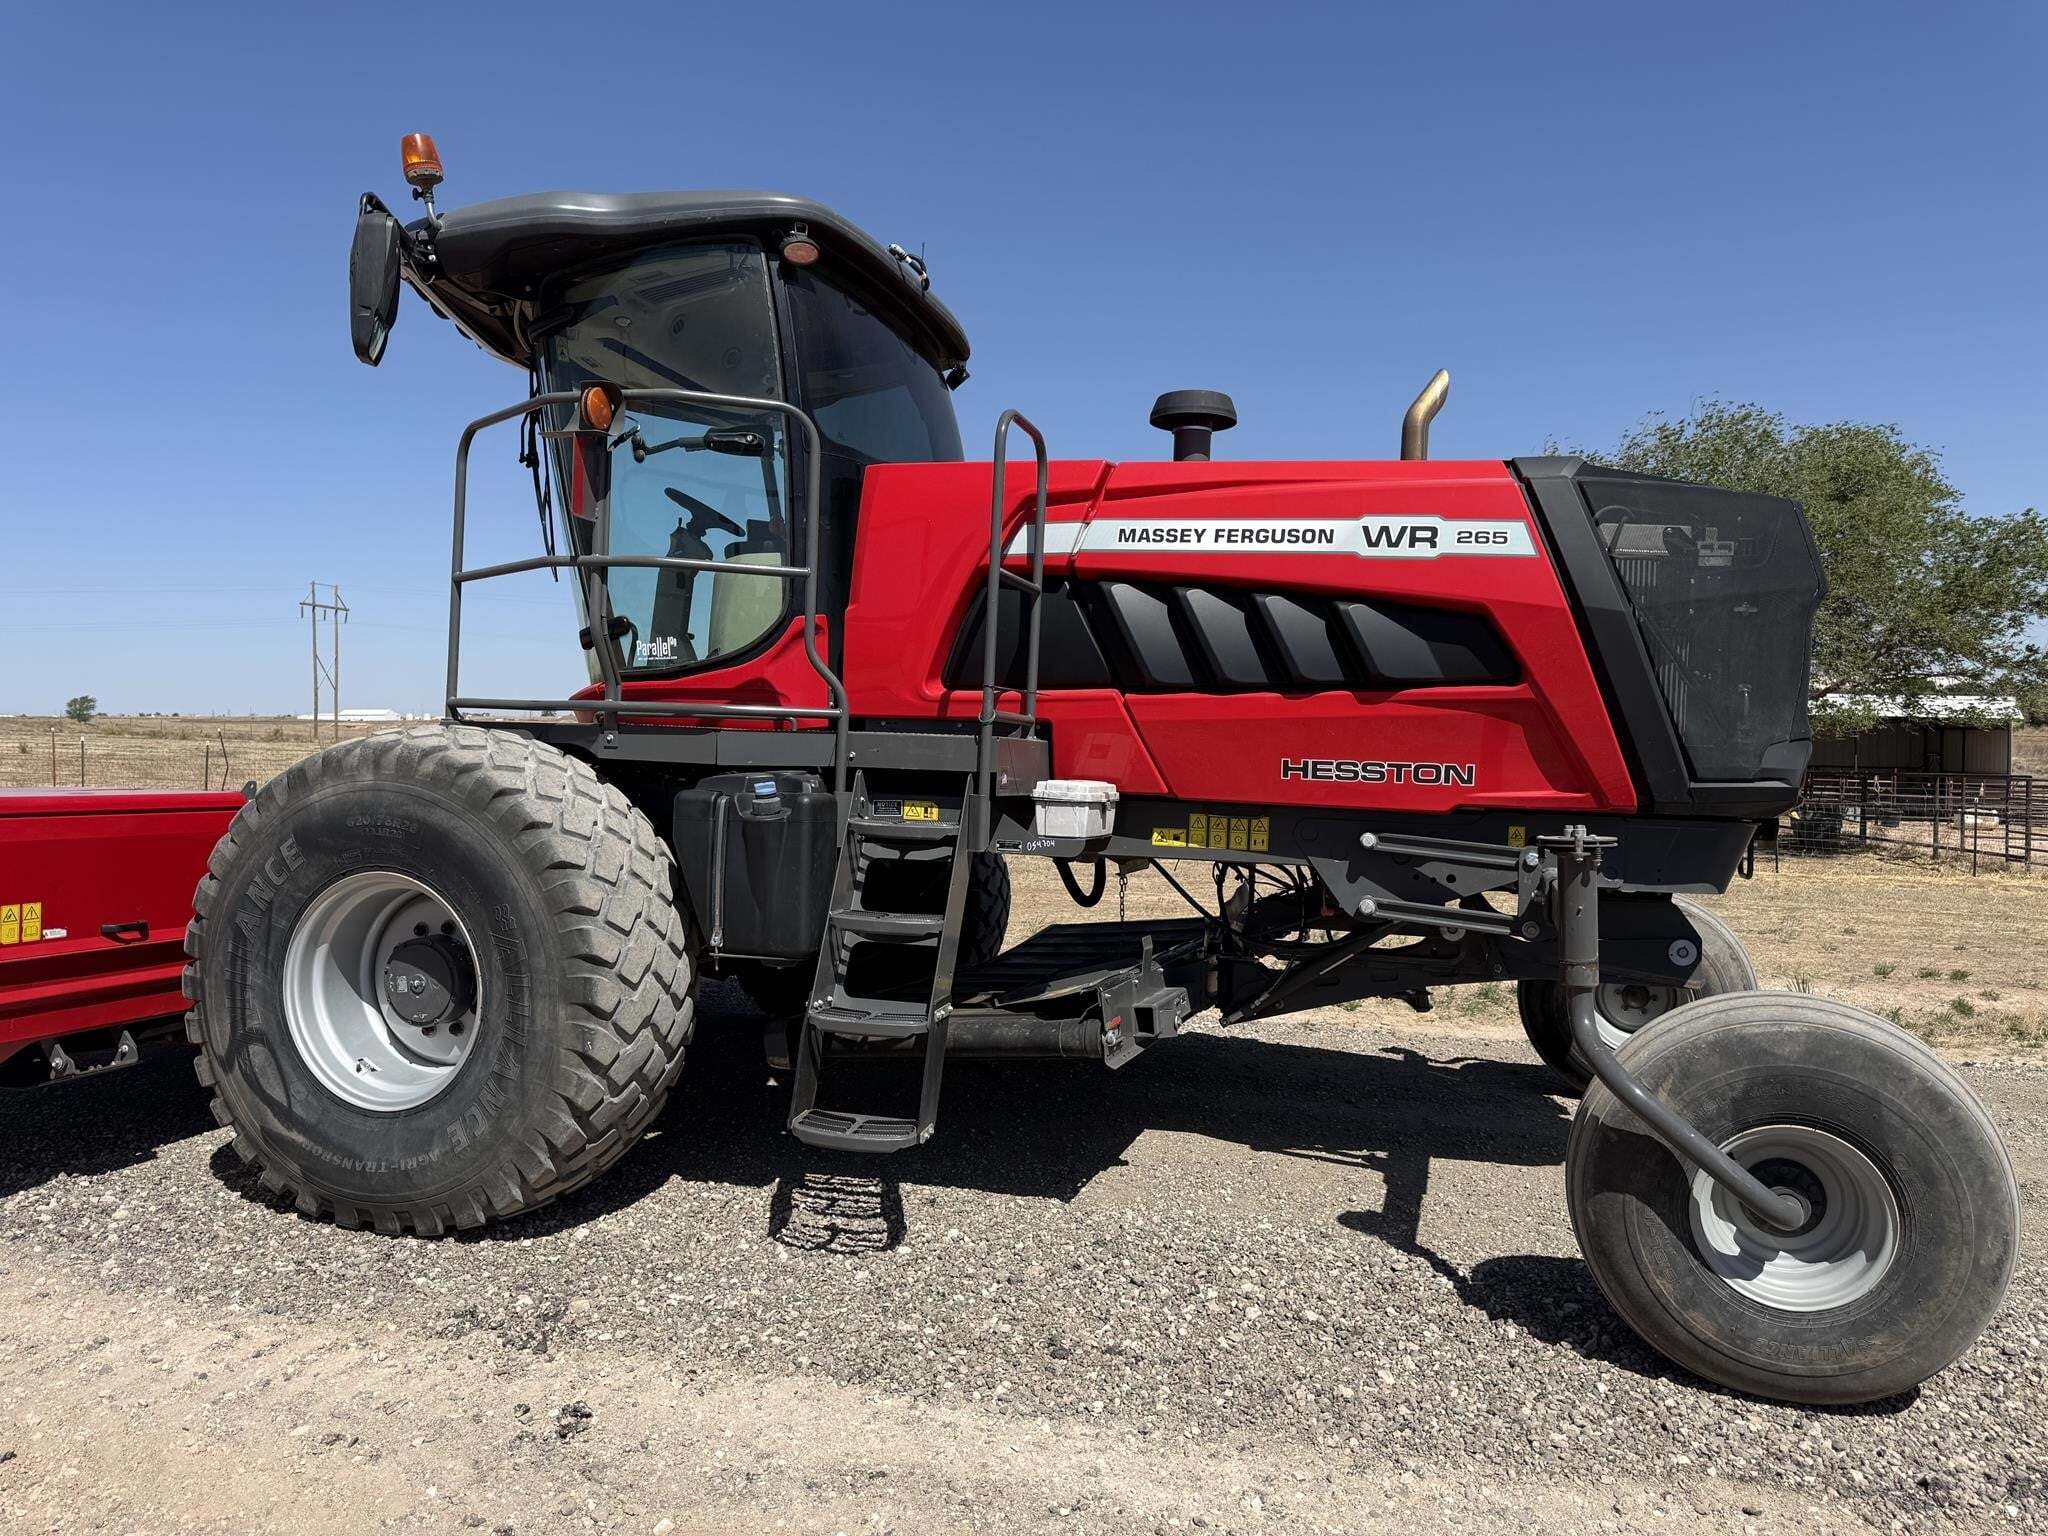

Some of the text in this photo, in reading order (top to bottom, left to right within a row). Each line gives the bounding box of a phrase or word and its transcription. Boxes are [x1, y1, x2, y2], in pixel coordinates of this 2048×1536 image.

[1117, 525, 1509, 549] MASSEY FERGUSON WR 265
[636, 636, 671, 657] Parallel
[1280, 757, 1476, 787] HESSTON
